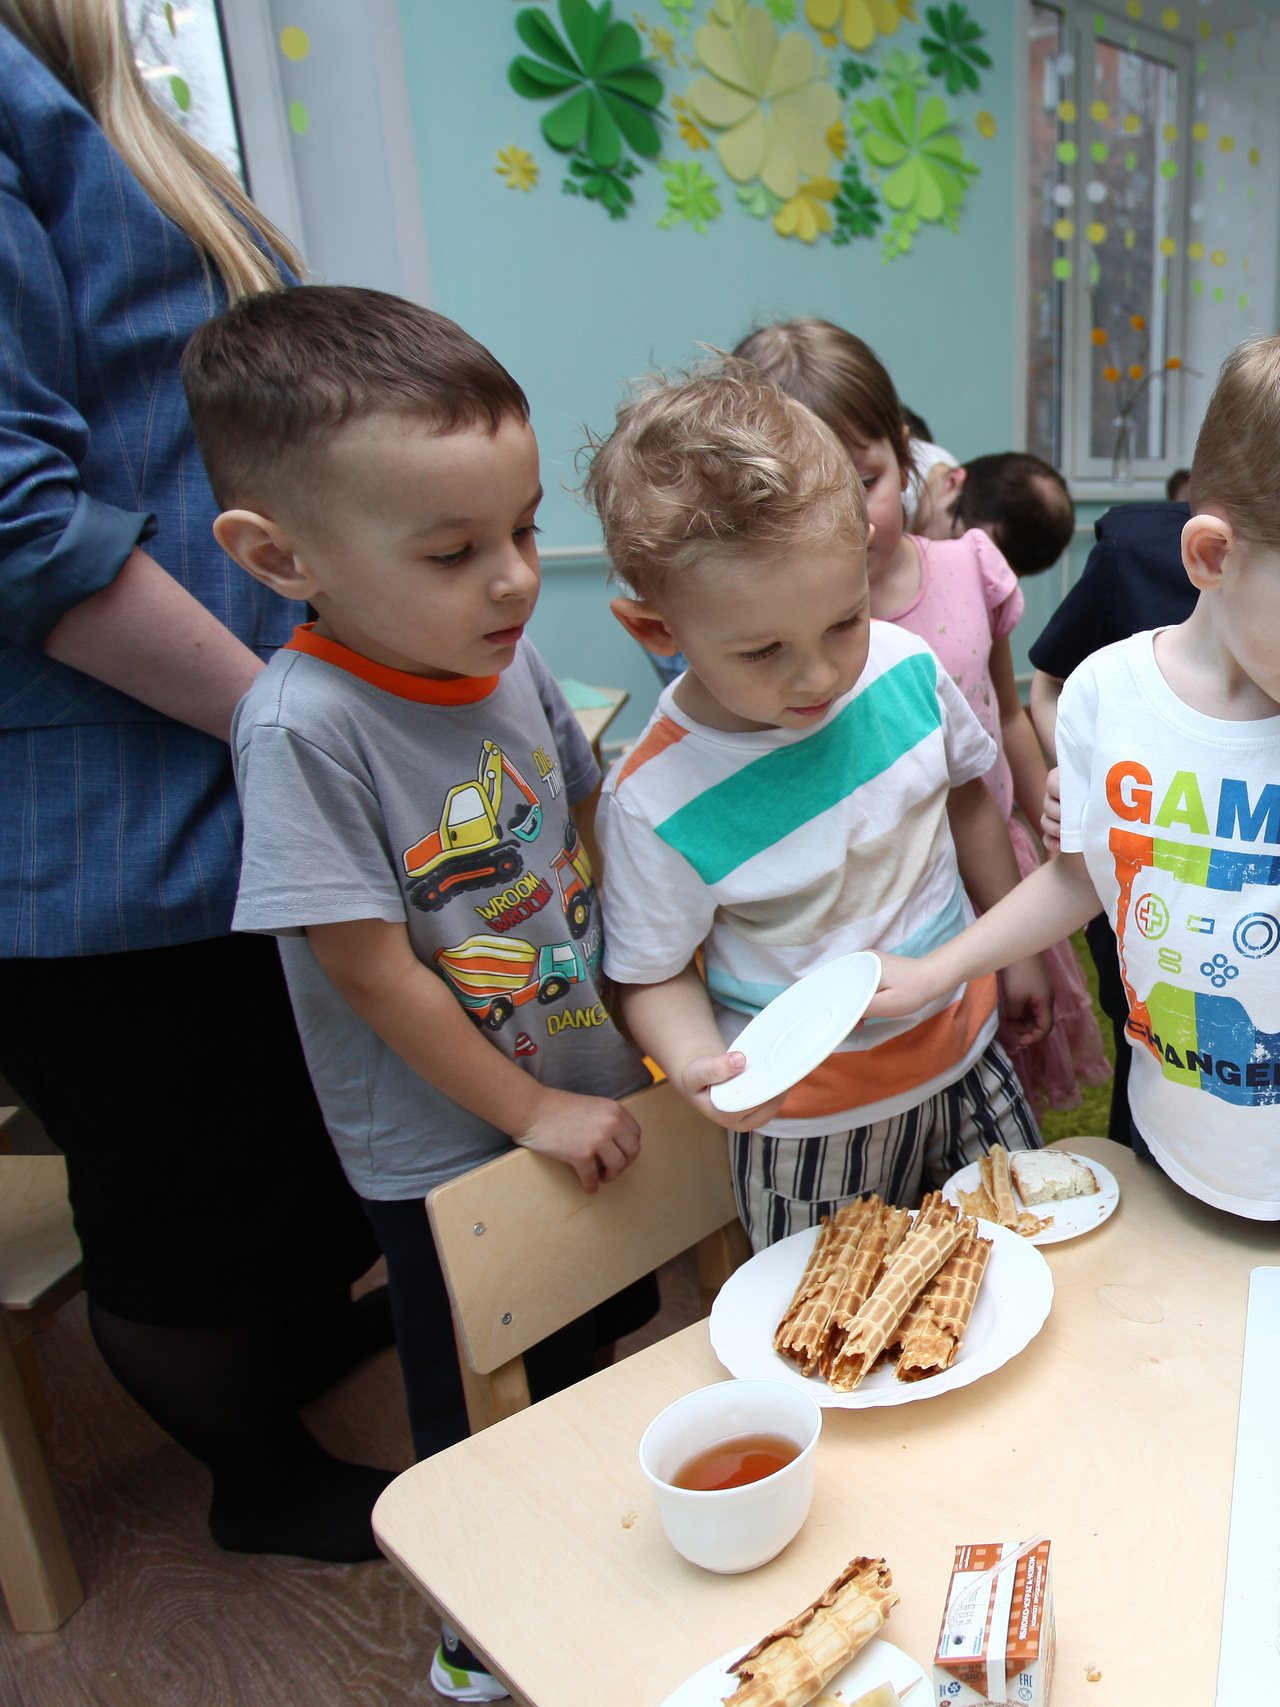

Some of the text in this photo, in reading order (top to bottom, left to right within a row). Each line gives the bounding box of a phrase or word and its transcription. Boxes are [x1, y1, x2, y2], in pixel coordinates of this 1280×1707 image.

[533, 745, 553, 777] DIG
[474, 870, 541, 920] WROOM
[485, 878, 554, 934] WROOM!
[546, 1003, 608, 1037] DANG
